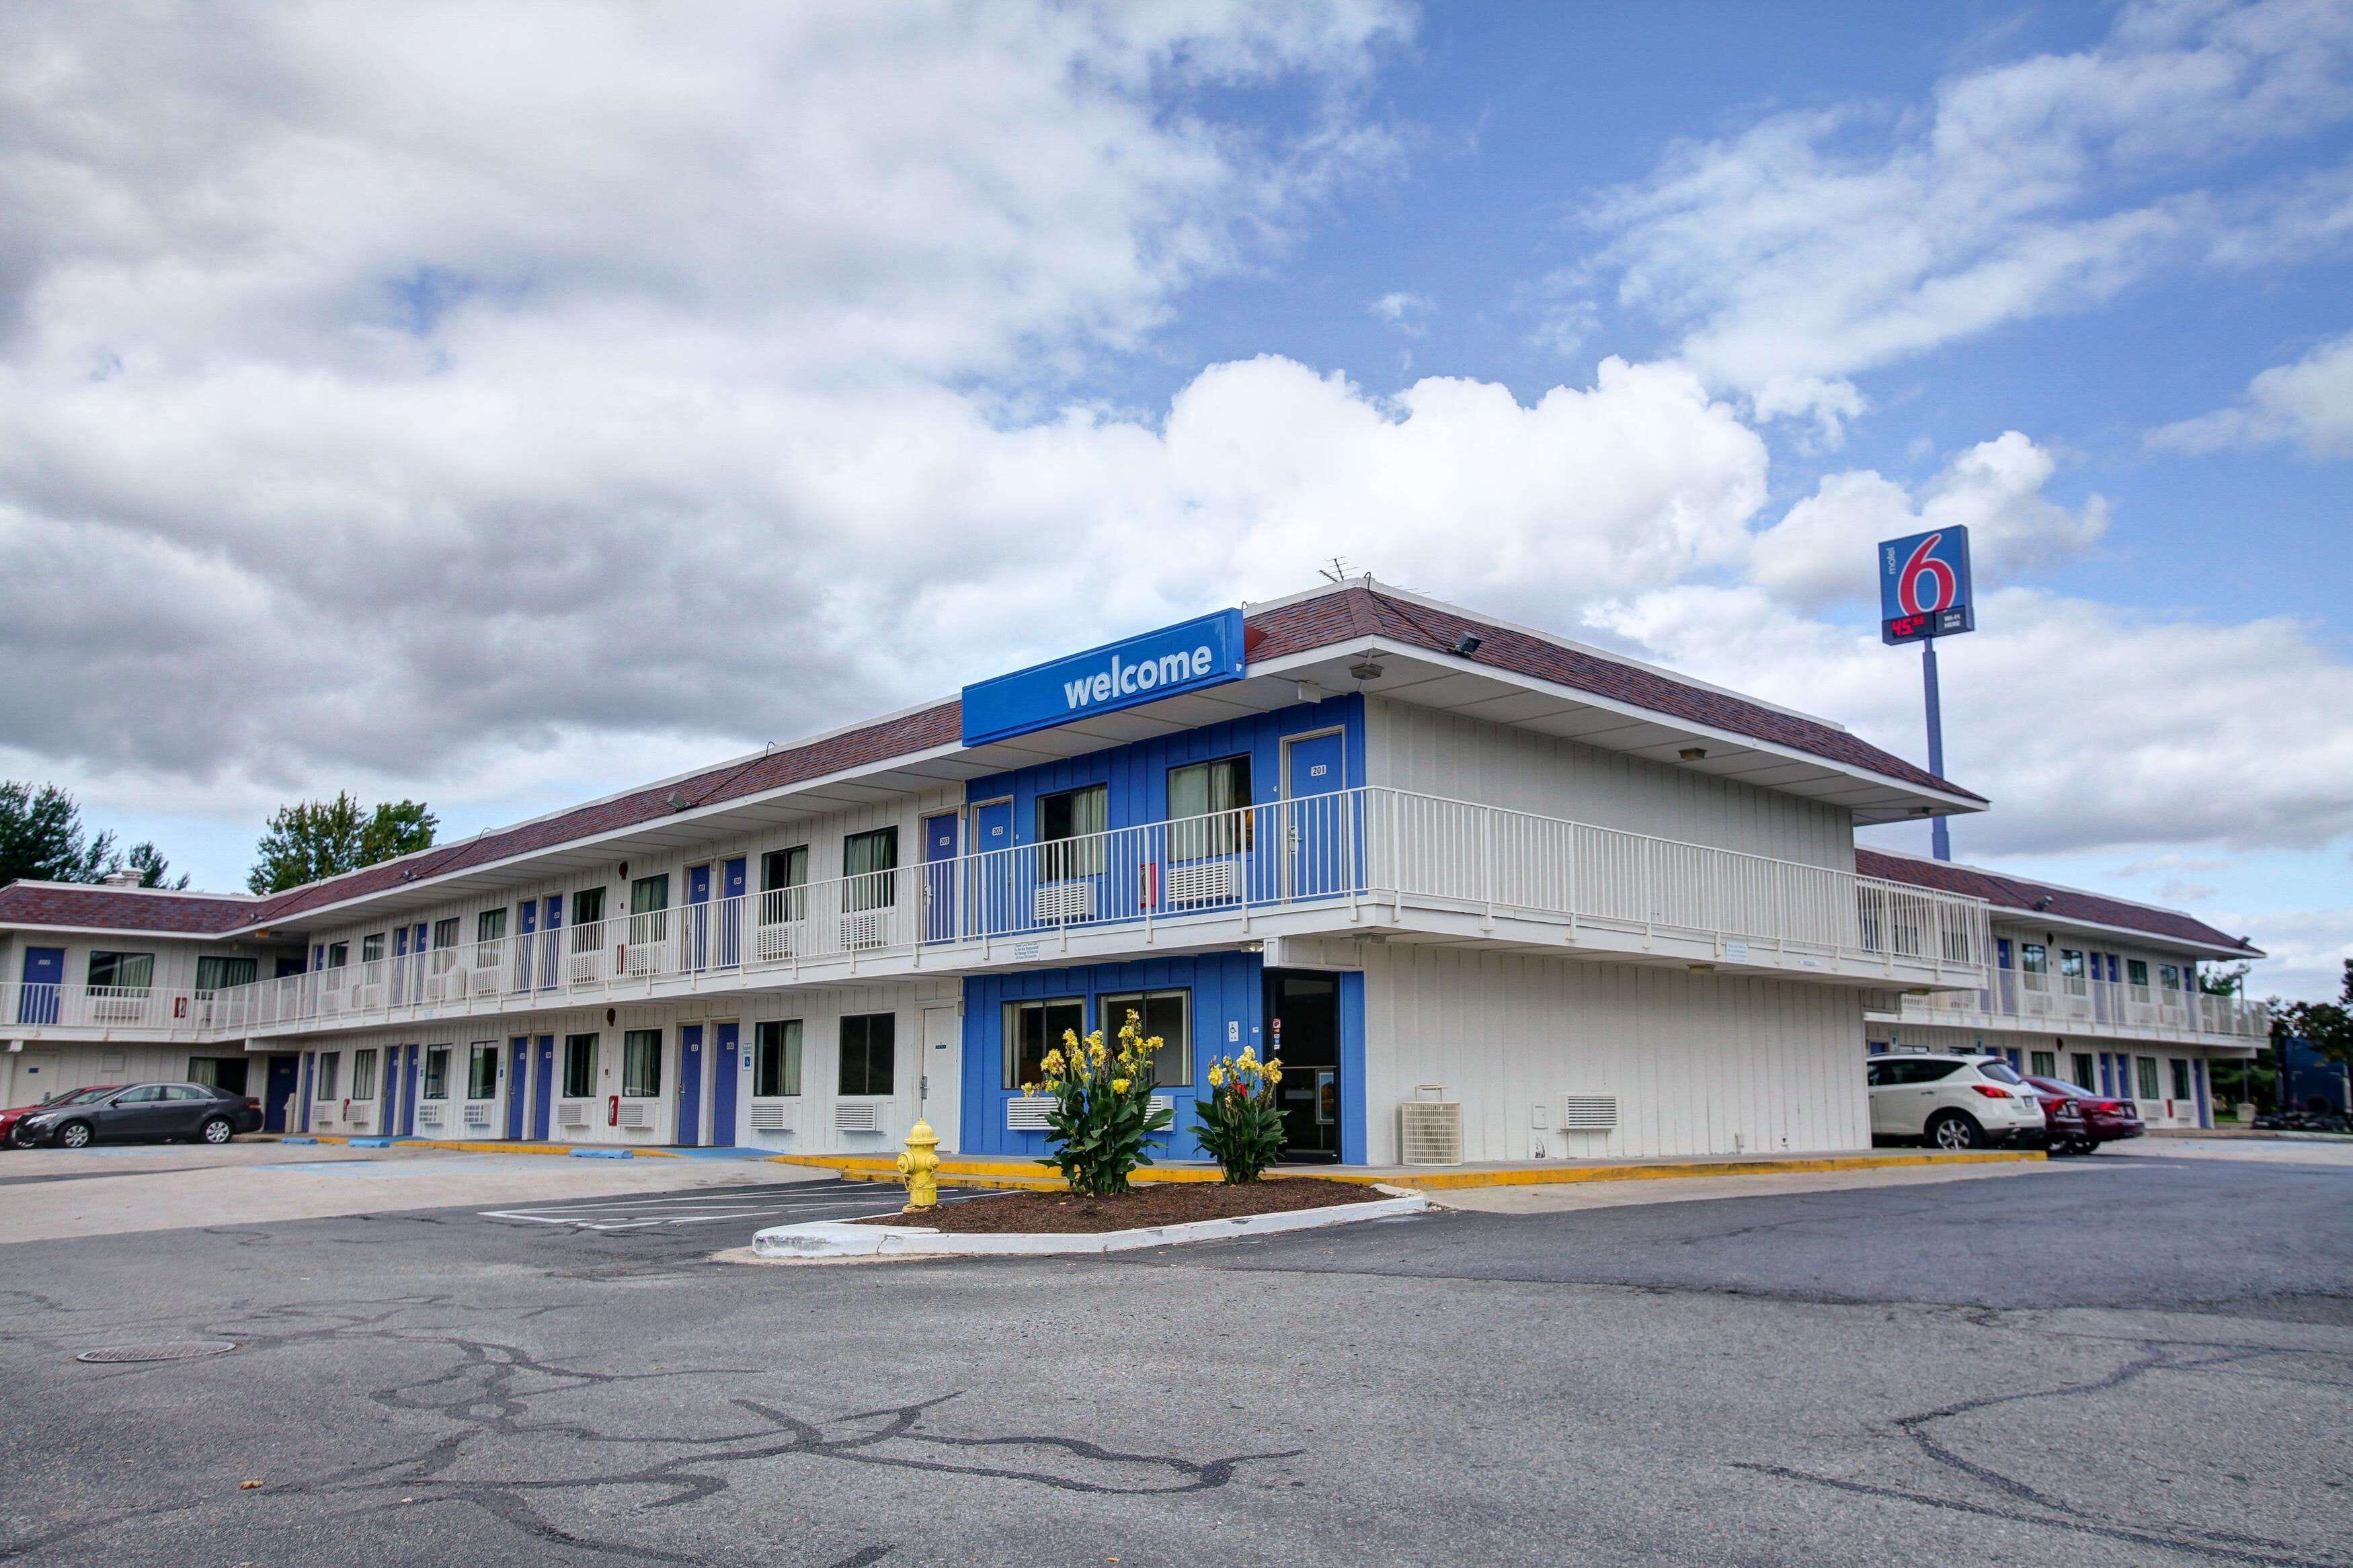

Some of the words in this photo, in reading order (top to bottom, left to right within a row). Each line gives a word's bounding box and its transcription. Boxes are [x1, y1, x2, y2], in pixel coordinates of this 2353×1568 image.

[1886, 546, 1896, 575] motel
[1897, 532, 1956, 616] 6
[1064, 646, 1212, 709] welcome
[1312, 766, 1324, 775] 201
